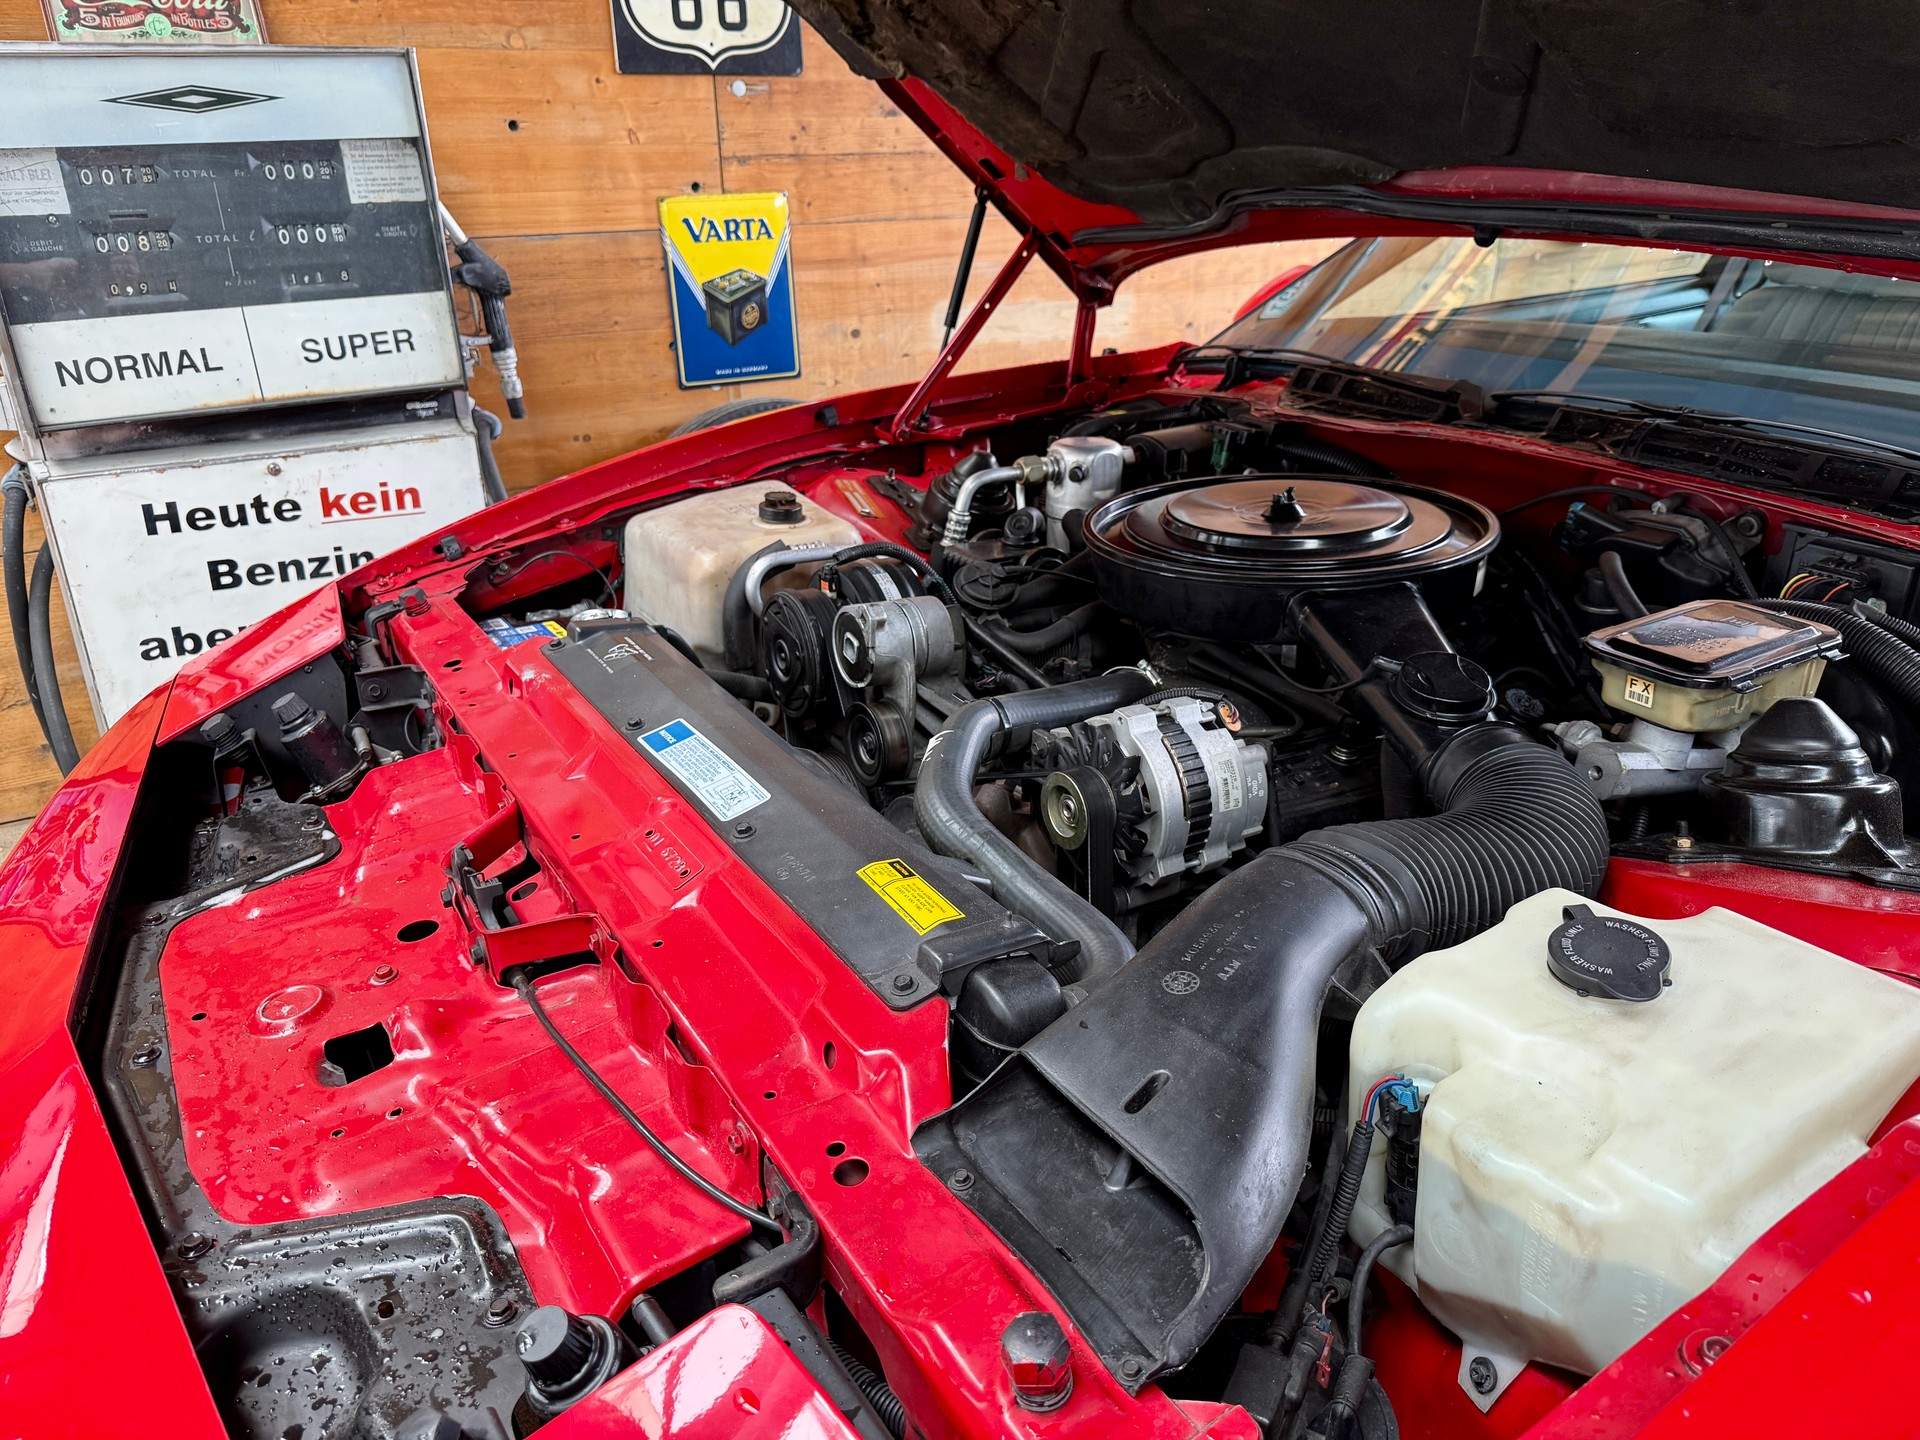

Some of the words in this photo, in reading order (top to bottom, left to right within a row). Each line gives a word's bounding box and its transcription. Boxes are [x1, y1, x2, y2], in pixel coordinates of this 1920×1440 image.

[102, 15, 111, 28] AT
[170, 13, 180, 25] IN
[80, 168, 133, 186] 007
[173, 169, 216, 178] TOTAL
[264, 163, 314, 181] 000
[278, 227, 327, 245] 000
[682, 216, 776, 243] VARTA
[96, 234, 150, 253] 008
[195, 234, 239, 244] TOTAL
[55, 346, 225, 388] NORMAL
[301, 327, 416, 364] SUPER
[140, 493, 303, 537] Heute
[319, 481, 424, 519] kein
[206, 545, 376, 592] Benzin
[658, 729, 678, 745] NOTICE
[1564, 923, 1585, 938] ONLY
[1605, 920, 1649, 940] WASHER
[1561, 937, 1575, 956] FLUID
[1644, 938, 1660, 957] FLUID
[1570, 955, 1614, 976] WASHER
[1636, 957, 1657, 972] ONLY
